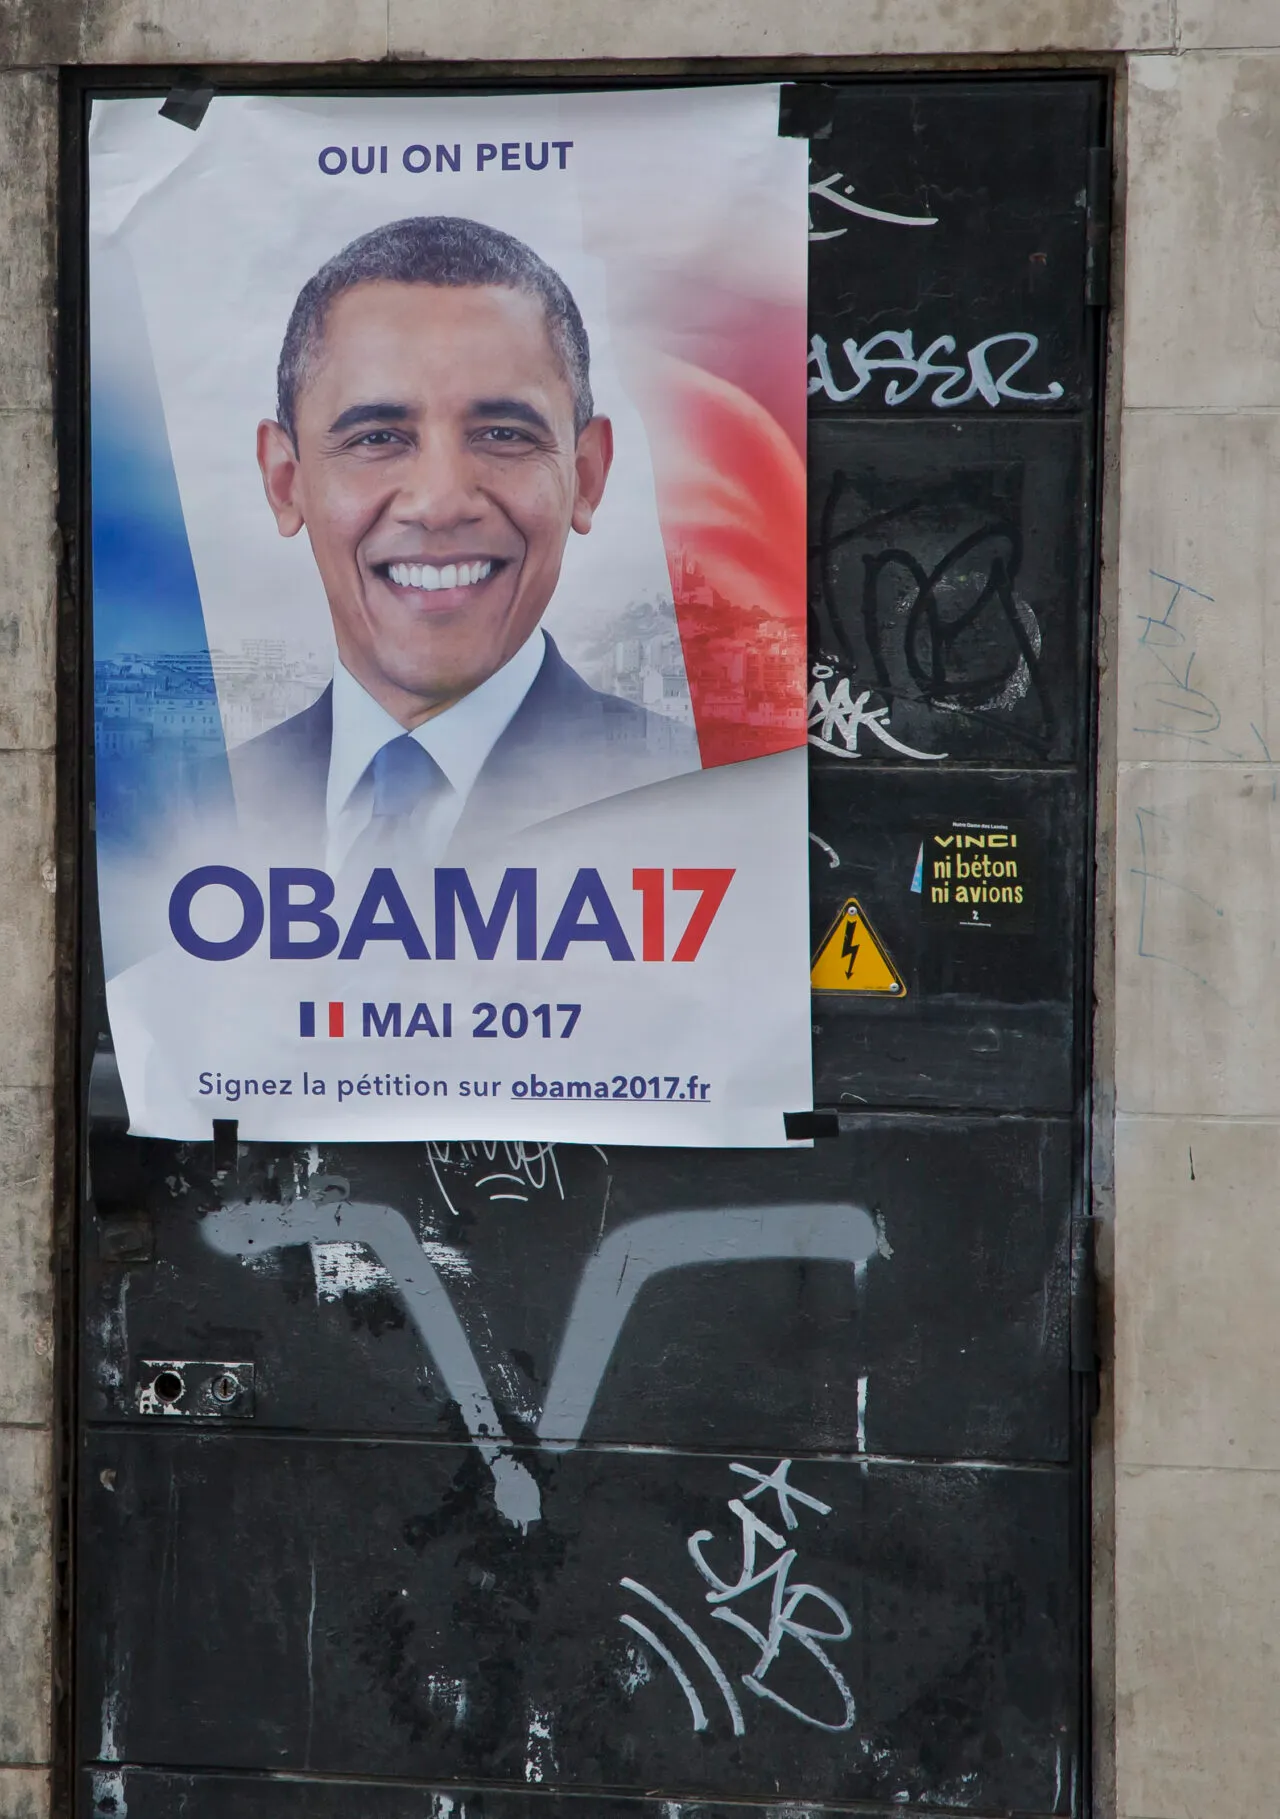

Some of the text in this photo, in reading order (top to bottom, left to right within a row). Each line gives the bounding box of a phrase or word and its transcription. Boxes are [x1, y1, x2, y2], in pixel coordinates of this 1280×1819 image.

[318, 141, 575, 176] OUI ON PEUT
[933, 834, 1017, 849] VINCI
[933, 853, 1018, 879] ni béton
[931, 879, 1024, 904] ni avions
[168, 864, 737, 963] OBAMA17
[362, 1002, 583, 1039] MAI 2017
[198, 1071, 712, 1104] Signez la pétition sur obama2017.fr
